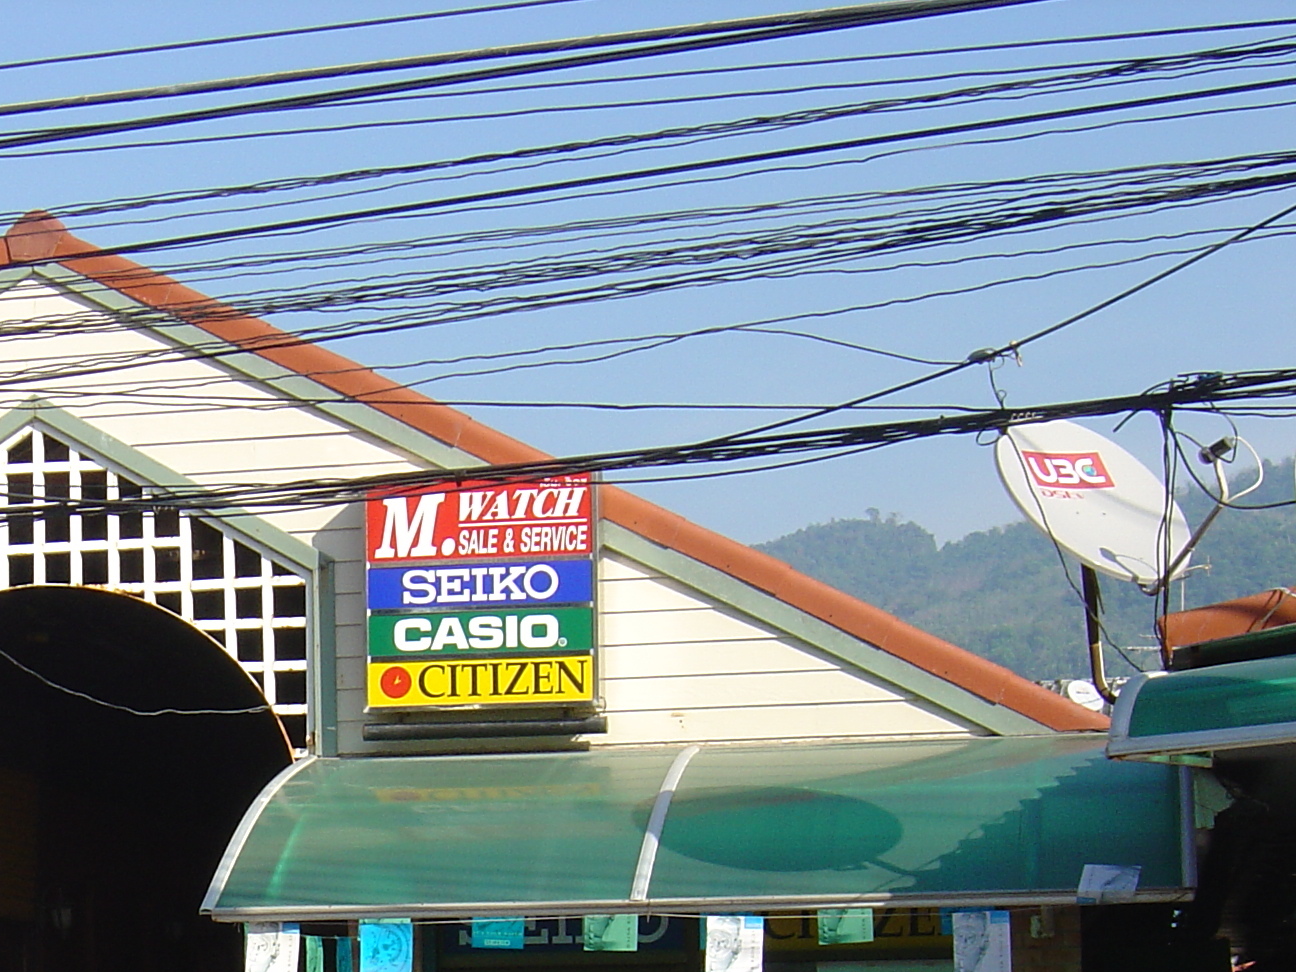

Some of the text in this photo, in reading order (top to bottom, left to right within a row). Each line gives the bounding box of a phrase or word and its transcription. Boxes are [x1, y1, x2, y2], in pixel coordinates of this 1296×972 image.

[1027, 457, 1107, 484] UBC
[375, 487, 587, 558] M. WATCH
[458, 525, 587, 555] SALE & SERVICE
[402, 564, 559, 604] SEIKO
[393, 614, 560, 652] CASIO
[418, 660, 587, 698] CITIZEN
